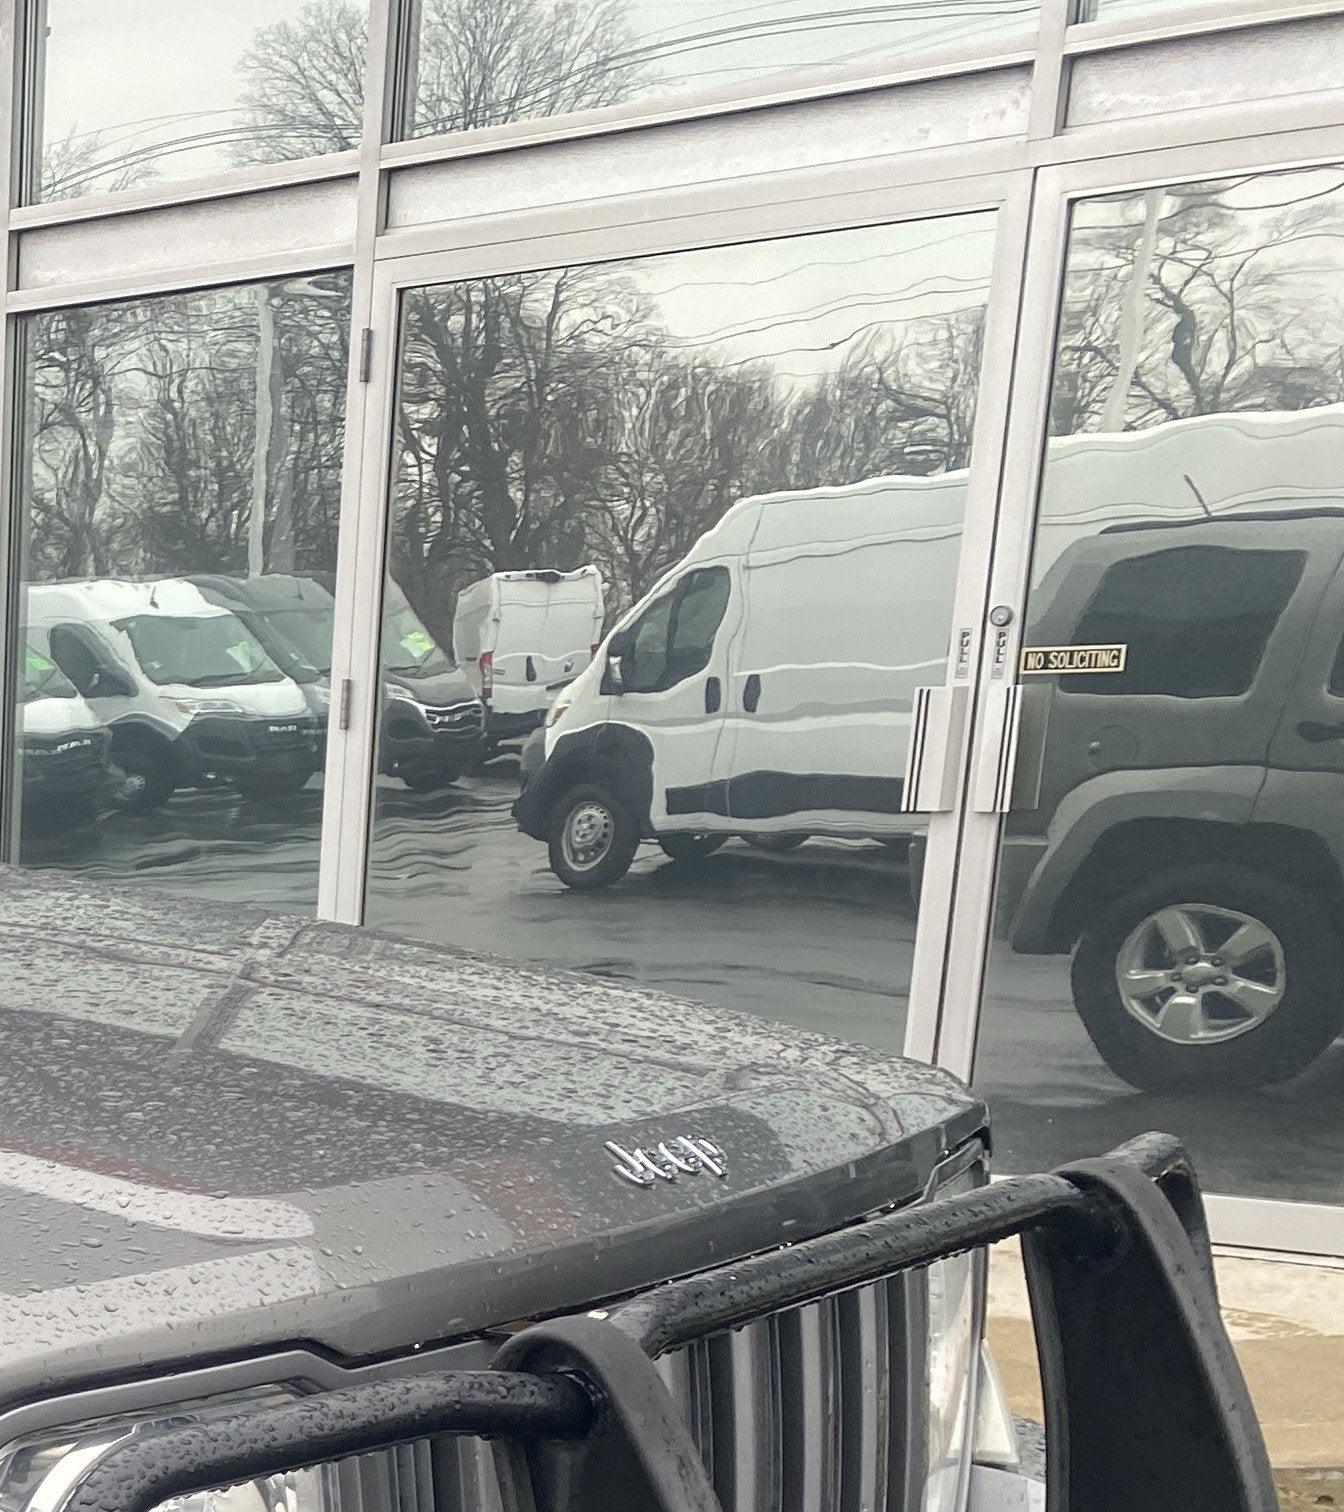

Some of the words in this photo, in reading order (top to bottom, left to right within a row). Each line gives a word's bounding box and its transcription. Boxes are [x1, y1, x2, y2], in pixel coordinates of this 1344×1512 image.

[960, 631, 970, 663] PULL
[995, 631, 1006, 663] PULL
[1026, 652, 1044, 669] NO
[1048, 649, 1119, 669] SOLICITING
[604, 1134, 728, 1187] Jeep
